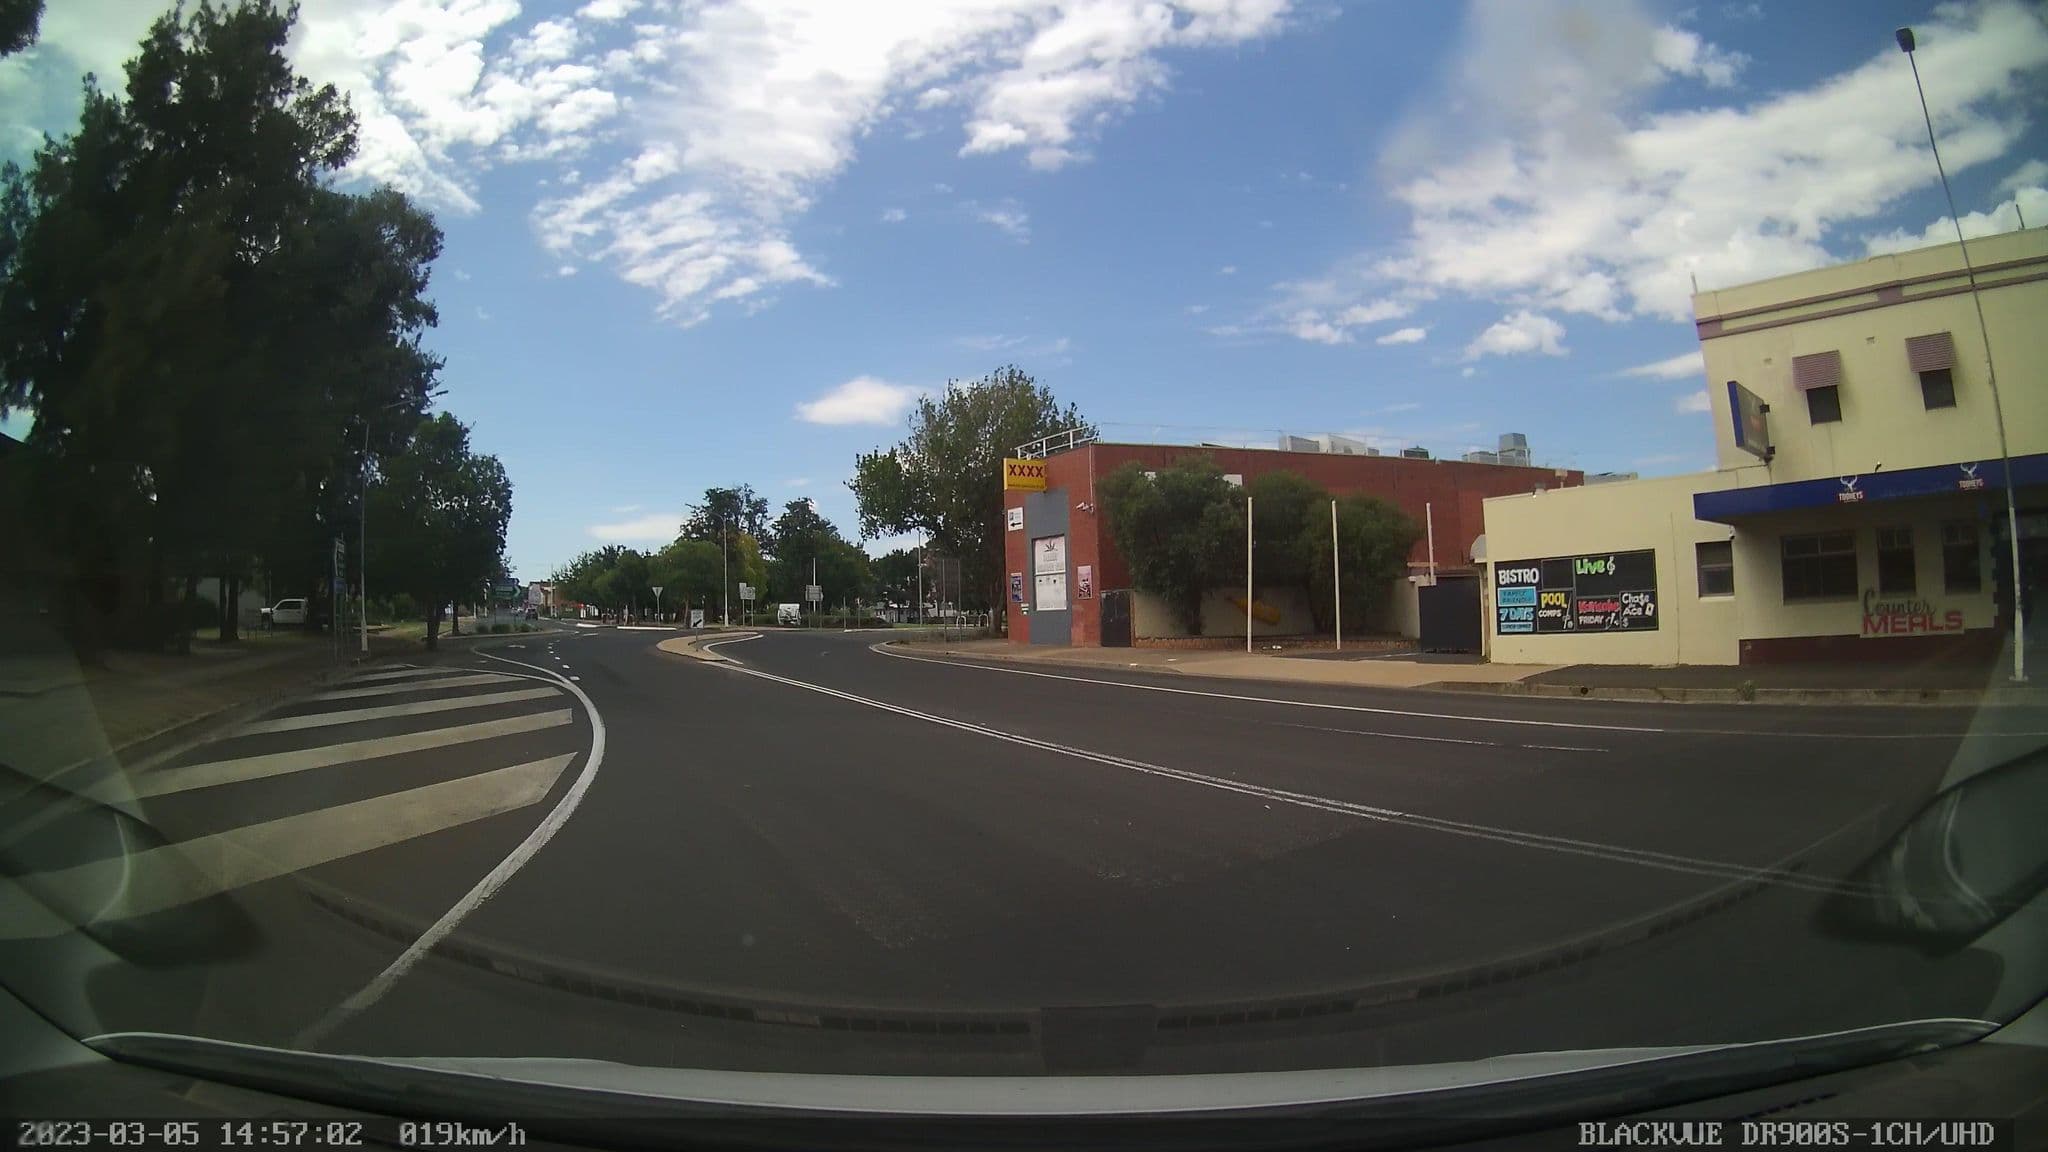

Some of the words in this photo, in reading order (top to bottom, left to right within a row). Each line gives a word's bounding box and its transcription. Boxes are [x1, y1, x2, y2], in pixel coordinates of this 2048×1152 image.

[1009, 464, 1043, 477] XXXX
[1575, 558, 1605, 574] Live
[1498, 568, 1539, 585] BISTRO
[1541, 592, 1567, 608] POOL
[1863, 587, 1936, 615] Counter
[1500, 607, 1508, 621] 7
[1509, 607, 1534, 620] DAYS
[1538, 609, 1562, 617] COMPS
[1579, 615, 1604, 624] FRIDAY
[1863, 610, 1963, 634] MEALS
